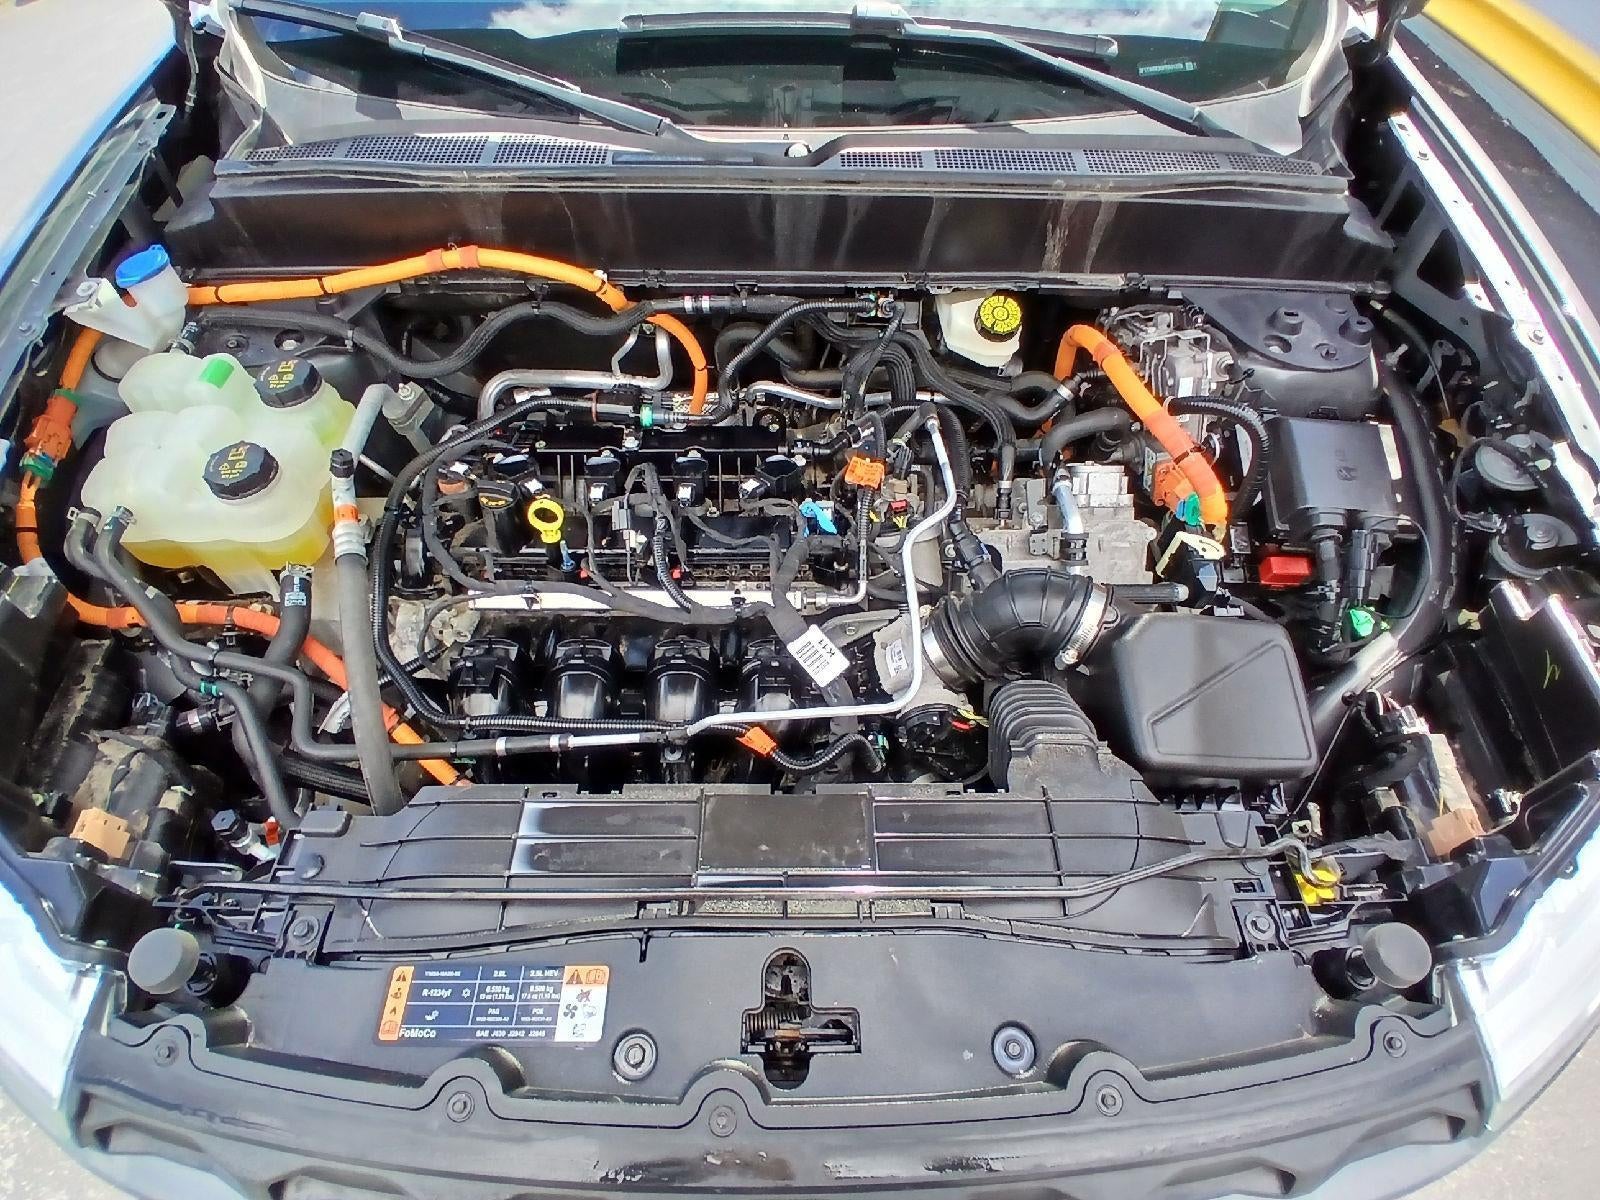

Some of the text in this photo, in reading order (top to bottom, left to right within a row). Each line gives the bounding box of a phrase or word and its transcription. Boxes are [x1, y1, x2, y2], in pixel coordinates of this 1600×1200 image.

[421, 988, 453, 998] R-1234yf
[399, 1028, 437, 1038] FoMoCo
[475, 1029, 490, 1037] SAE
